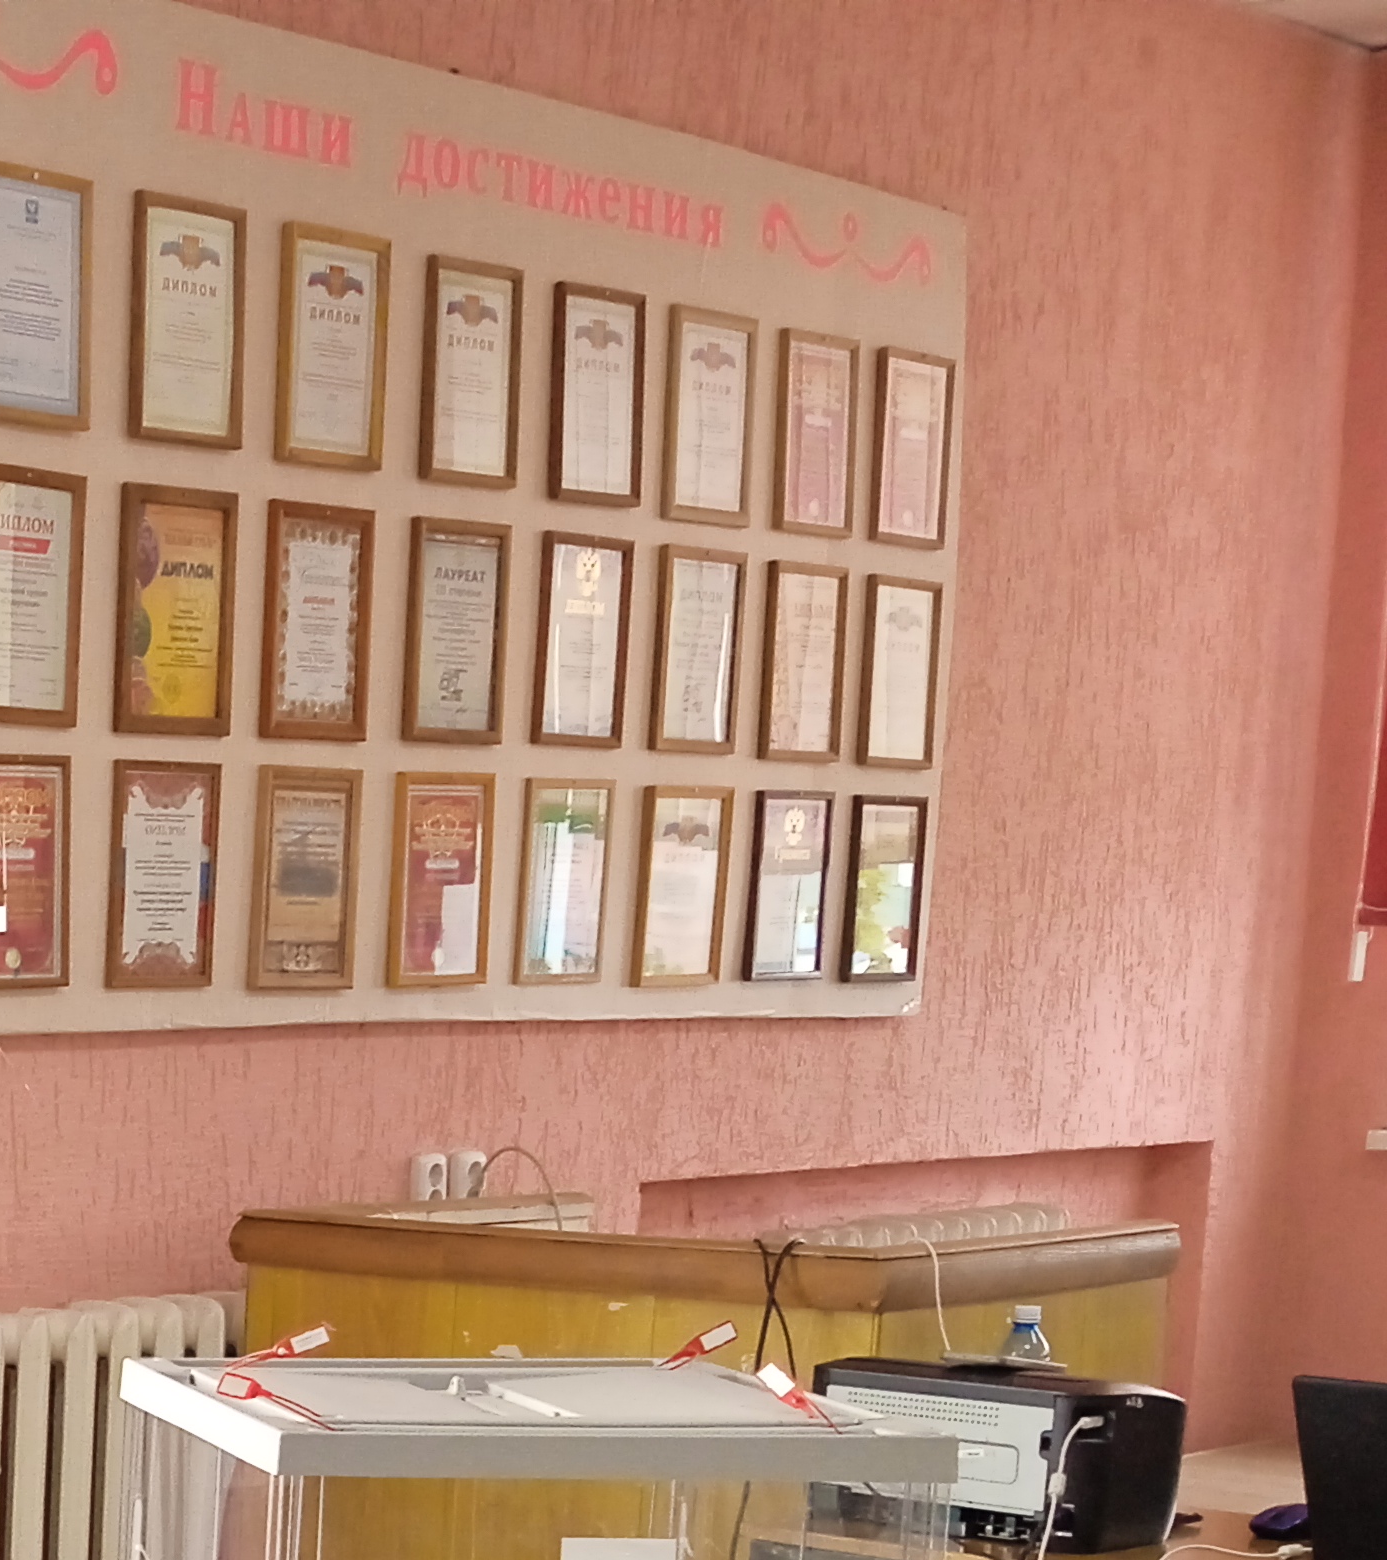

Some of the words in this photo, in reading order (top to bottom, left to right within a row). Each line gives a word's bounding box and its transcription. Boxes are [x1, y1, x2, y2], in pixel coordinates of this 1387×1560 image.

[397, 131, 724, 248] достижения
[162, 276, 218, 298] ДИПЛОМ
[309, 305, 362, 326] ДИПЛОМ
[447, 333, 495, 352] ДИПЛОМ
[160, 560, 214, 580] ДИПЛОМ
[434, 566, 487, 584] ЛАУРЕАТ
